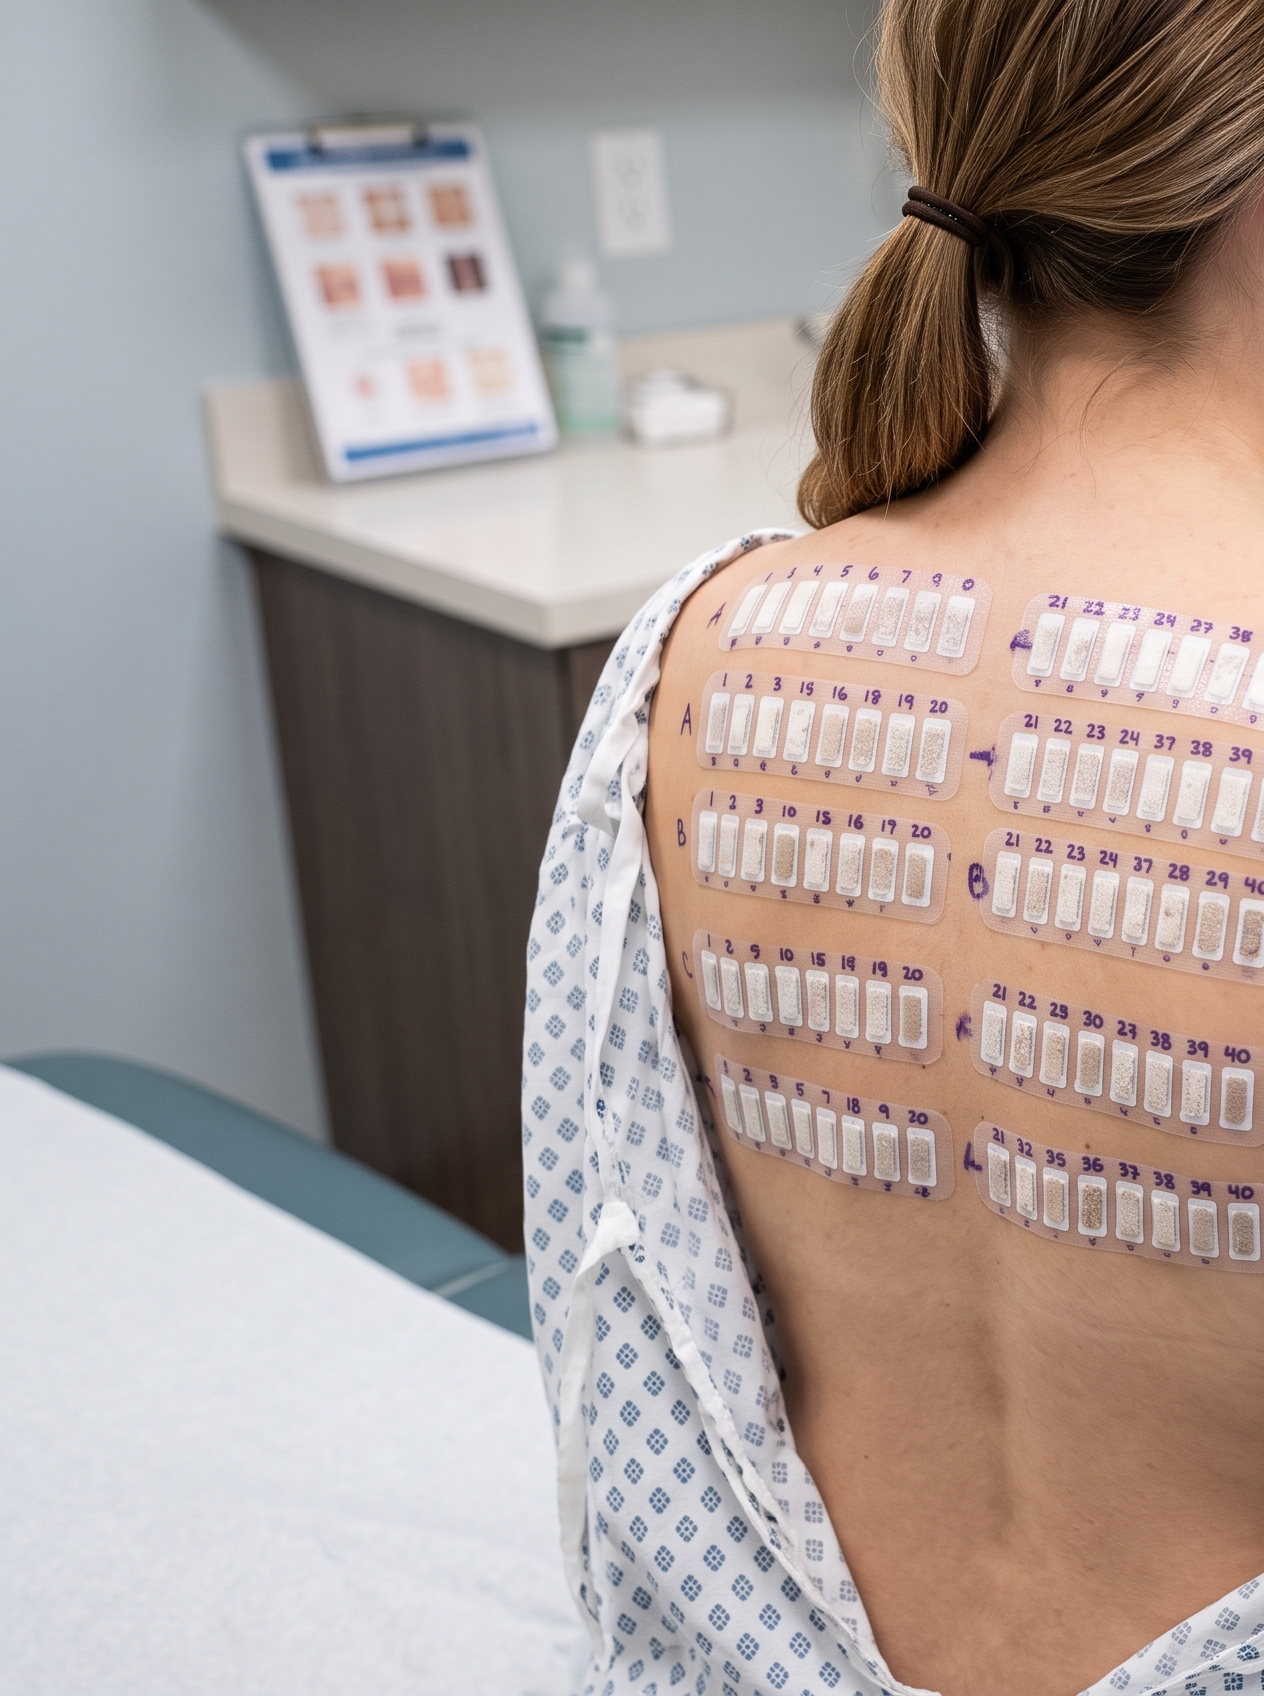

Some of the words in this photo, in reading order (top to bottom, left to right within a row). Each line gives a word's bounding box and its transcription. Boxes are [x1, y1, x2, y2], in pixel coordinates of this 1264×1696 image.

[813, 565, 824, 576] 4
[840, 564, 854, 578] 5
[867, 566, 880, 581] 6
[1048, 594, 1069, 610] 21
[1153, 612, 1177, 628] 24
[1189, 618, 1214, 634] 27
[744, 673, 753, 690] 2
[773, 676, 782, 692] 3
[799, 681, 815, 697] 15
[832, 685, 849, 702] 16
[864, 689, 882, 706] 18
[897, 693, 915, 711] 19
[929, 699, 949, 714] 20
[680, 703, 692, 735] A
[1023, 713, 1039, 730] 21
[1053, 718, 1073, 735] 22
[1086, 723, 1106, 741] 23
[1118, 728, 1141, 747] 24
[1153, 733, 1177, 751] 37
[1190, 739, 1213, 758] 38
[1228, 746, 1253, 765] 39
[676, 818, 687, 847] B
[728, 794, 737, 811] 2
[754, 798, 764, 815] 3
[781, 805, 797, 818] 10
[815, 810, 832, 826] 15
[847, 814, 864, 831] 16
[881, 818, 897, 835] 19
[911, 823, 932, 840] 20
[1004, 831, 1020, 848] 21
[1034, 837, 1054, 855] 22
[1066, 843, 1086, 862] 23
[1099, 849, 1119, 869] 24
[1133, 855, 1154, 874] 37
[1205, 870, 1230, 890] 29
[779, 947, 795, 962] 10
[811, 952, 826, 968] 15
[902, 965, 924, 982] 20
[992, 983, 1007, 1001] 21
[1017, 990, 1038, 1011] 22
[1082, 1010, 1105, 1030] 30
[1150, 1029, 1173, 1051] 38
[1187, 1039, 1210, 1059] 39
[1223, 1045, 1252, 1065] 40
[742, 1067, 753, 1083] 2
[795, 1082, 805, 1097] 5
[821, 1089, 831, 1105] 7
[878, 1103, 890, 1120] 9
[908, 1109, 929, 1126] 20
[992, 1127, 1005, 1145] 21
[1045, 1149, 1067, 1168] 35
[1081, 1155, 1105, 1173] 36
[1118, 1161, 1141, 1181] 37
[1153, 1171, 1176, 1191] 38
[1190, 1180, 1212, 1197] 39
[1227, 1184, 1255, 1201] 40
